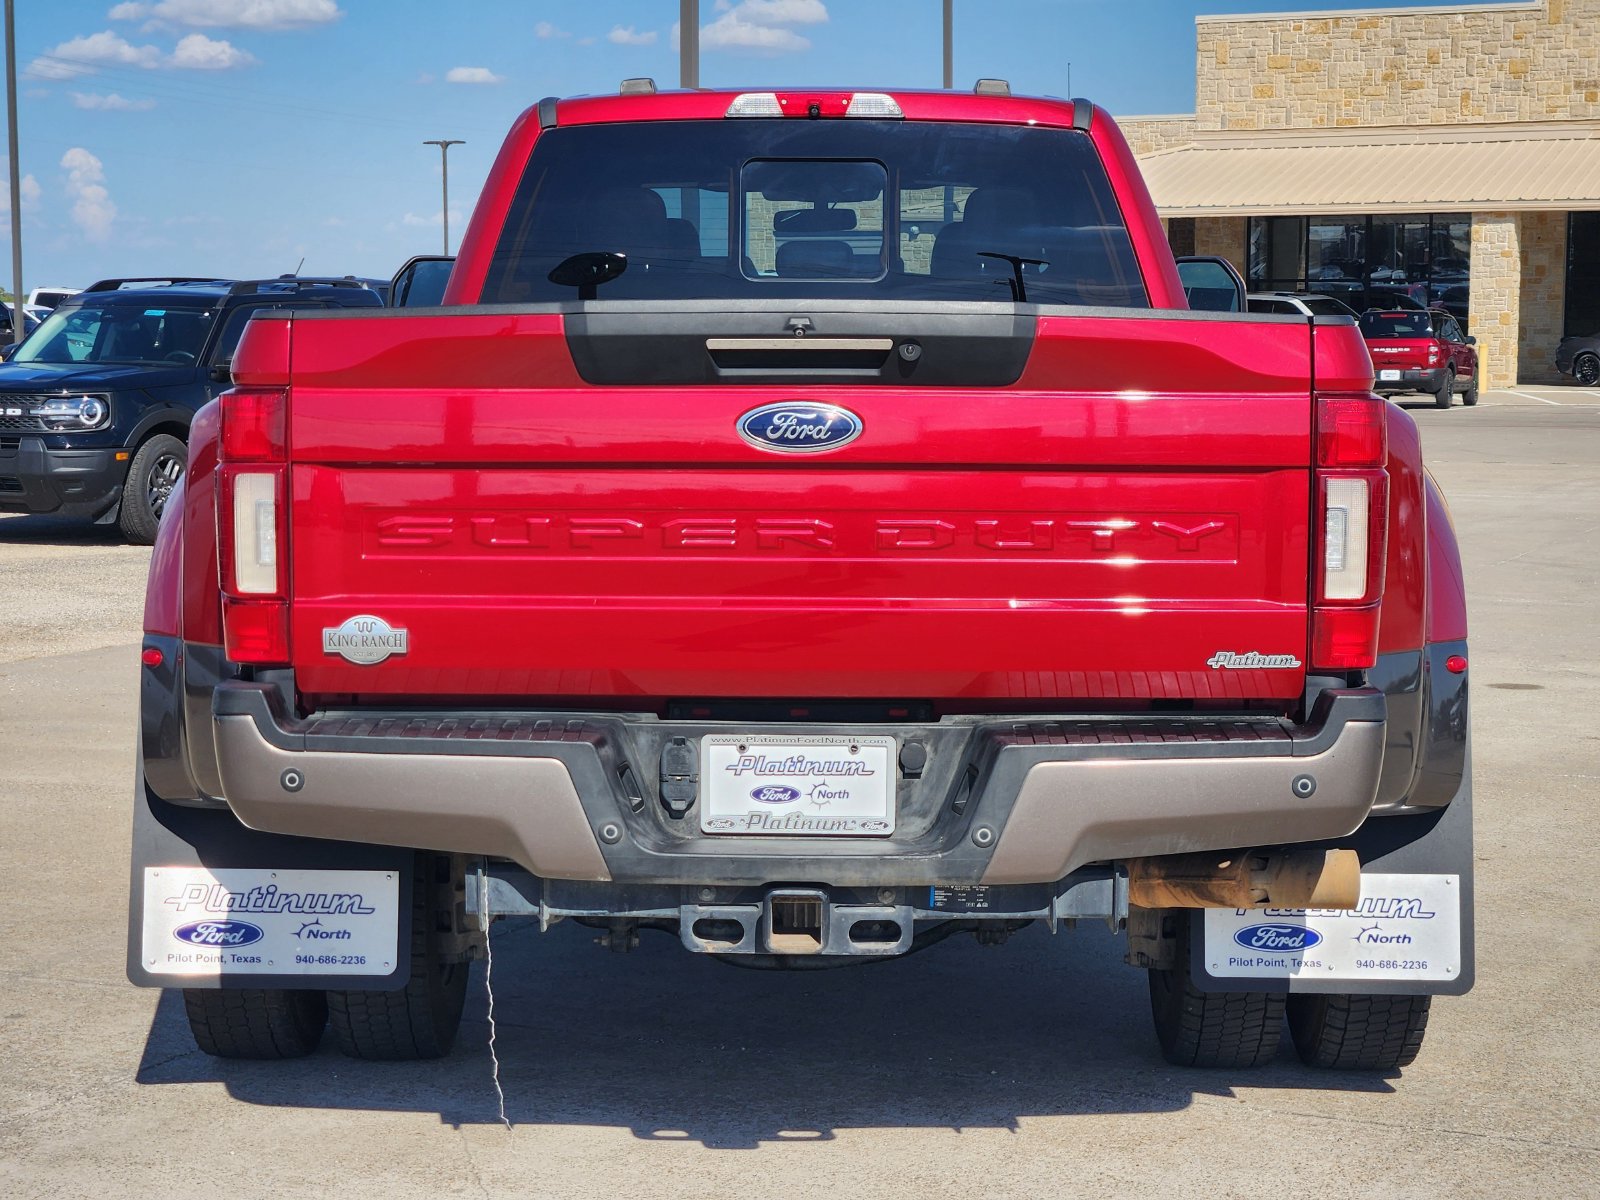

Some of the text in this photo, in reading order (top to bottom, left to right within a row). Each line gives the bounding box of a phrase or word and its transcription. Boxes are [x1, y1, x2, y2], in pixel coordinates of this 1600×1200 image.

[766, 412, 833, 440] Ford
[377, 515, 1225, 552] SUPER DUTY
[328, 632, 403, 648] KING RANCH
[1207, 650, 1302, 669] Platinum
[711, 736, 888, 744] www.PlatinumFordNorth.com
[725, 755, 875, 776] Platinum
[760, 787, 791, 801] Ford
[817, 789, 850, 800] North
[746, 813, 857, 831] Platinum
[164, 883, 376, 915] Platinum
[190, 922, 246, 944] Ford
[306, 929, 352, 940] North
[1251, 926, 1304, 948] Ford
[1366, 933, 1412, 944] North
[167, 953, 262, 965] Pilot Point, Texas
[295, 955, 367, 965] 940-686-2236
[1229, 957, 1322, 969] Pilot Point, Texas
[1356, 959, 1428, 970] 940-686-2236
